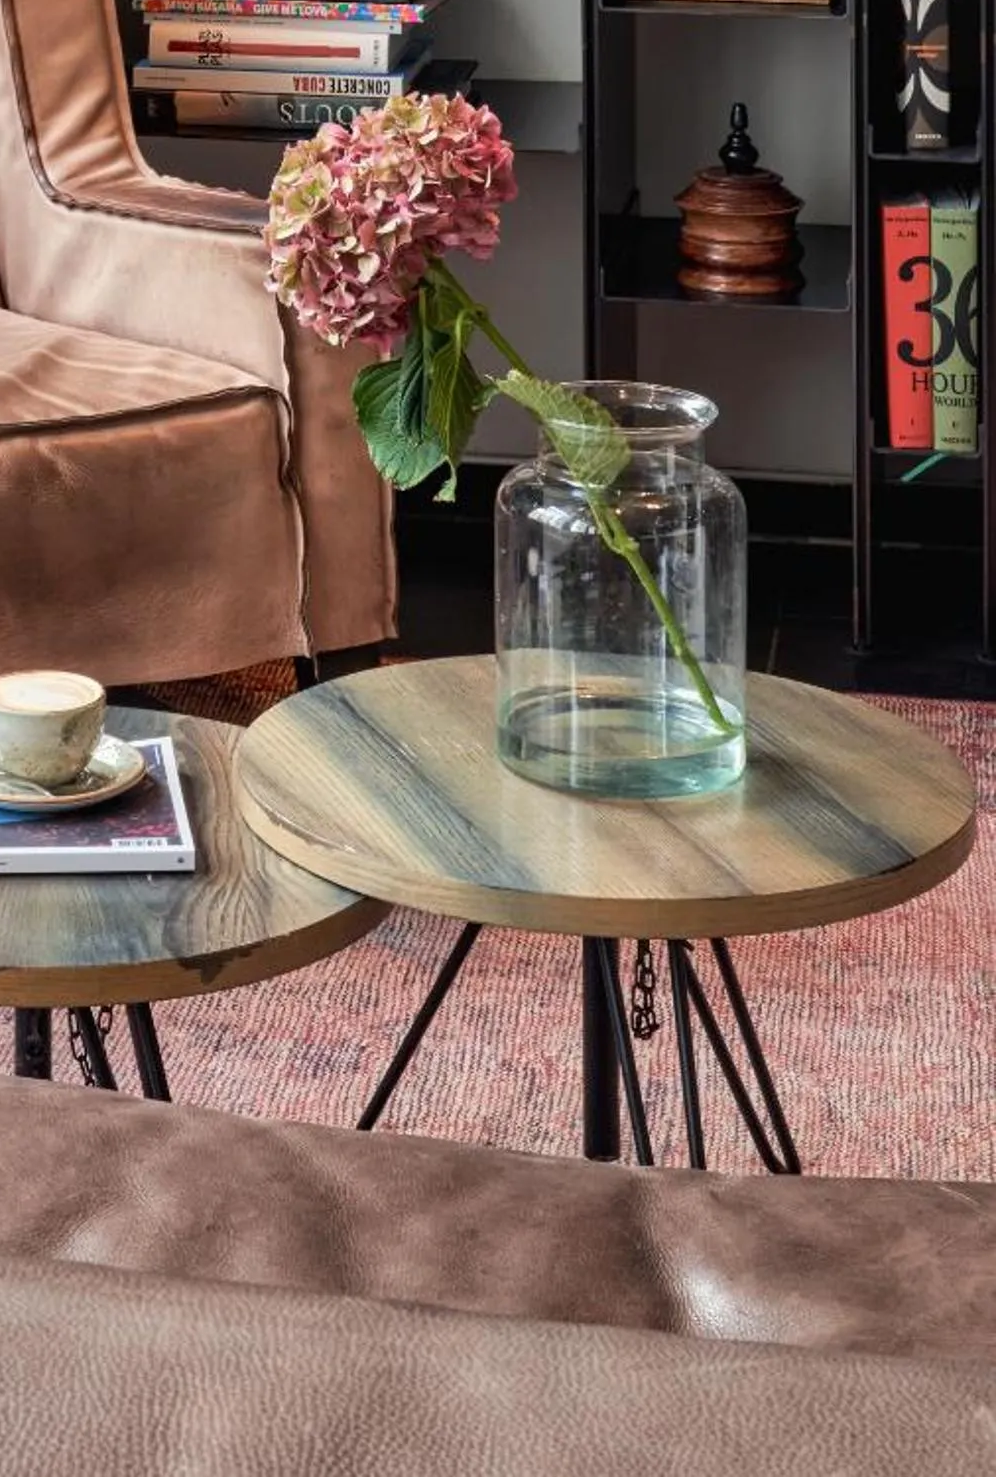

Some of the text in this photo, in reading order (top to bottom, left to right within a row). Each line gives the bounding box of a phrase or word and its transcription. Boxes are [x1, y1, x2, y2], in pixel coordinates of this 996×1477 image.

[253, 3, 280, 14] GIVE
[281, 4, 297, 15] ME
[299, 5, 328, 17] LOVE
[293, 76, 391, 96] CONCRETE CUBA
